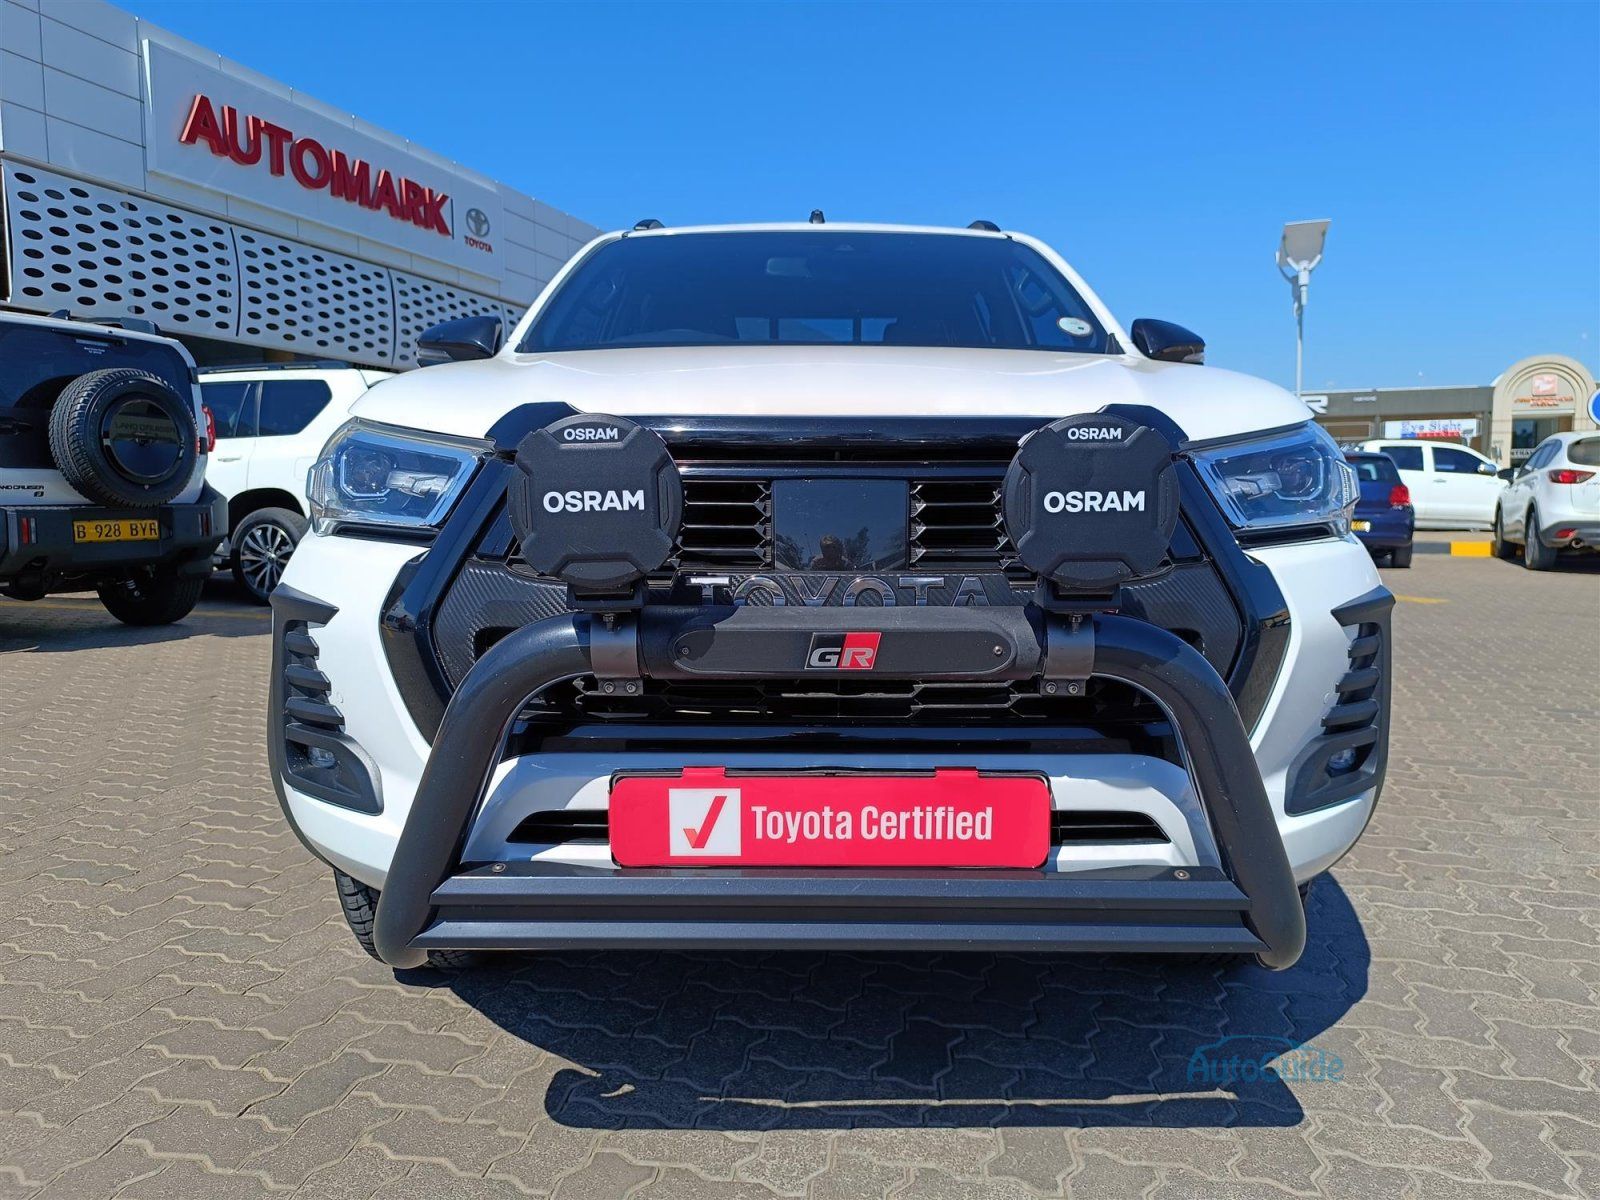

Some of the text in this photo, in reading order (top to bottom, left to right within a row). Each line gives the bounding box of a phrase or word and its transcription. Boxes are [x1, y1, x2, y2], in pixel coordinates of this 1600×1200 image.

[179, 94, 451, 235] AUTOMARK
[464, 235, 493, 254] TOYOTA
[563, 428, 618, 440] OSRAM
[1067, 427, 1122, 440] OSRAM
[1401, 419, 1462, 432] Eye Sight
[543, 490, 645, 513] OSRAM
[1043, 491, 1145, 513] OSRAM
[77, 523, 157, 538] B 928 BYR
[686, 576, 991, 607] TOYOTA
[809, 647, 874, 667] GR
[751, 805, 993, 843] Toyota Certified
